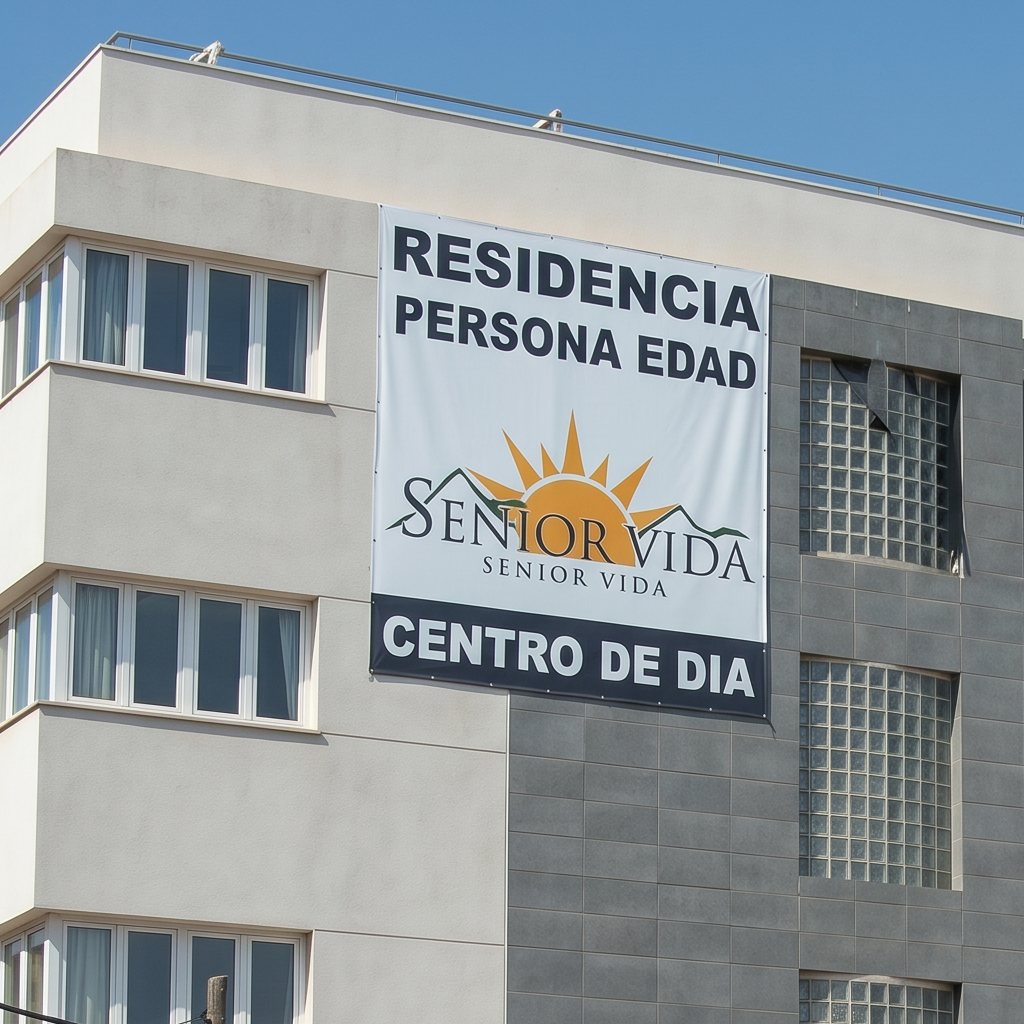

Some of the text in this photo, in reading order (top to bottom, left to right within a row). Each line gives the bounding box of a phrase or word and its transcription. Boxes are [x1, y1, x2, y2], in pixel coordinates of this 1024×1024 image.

[393, 225, 761, 333] RESIDENCIA
[395, 294, 757, 390] PERSONA EDAD
[482, 555, 667, 599] SENIOR VIDA
[623, 523, 756, 584] VIDA
[382, 614, 756, 699] CENTRO DE DIA
